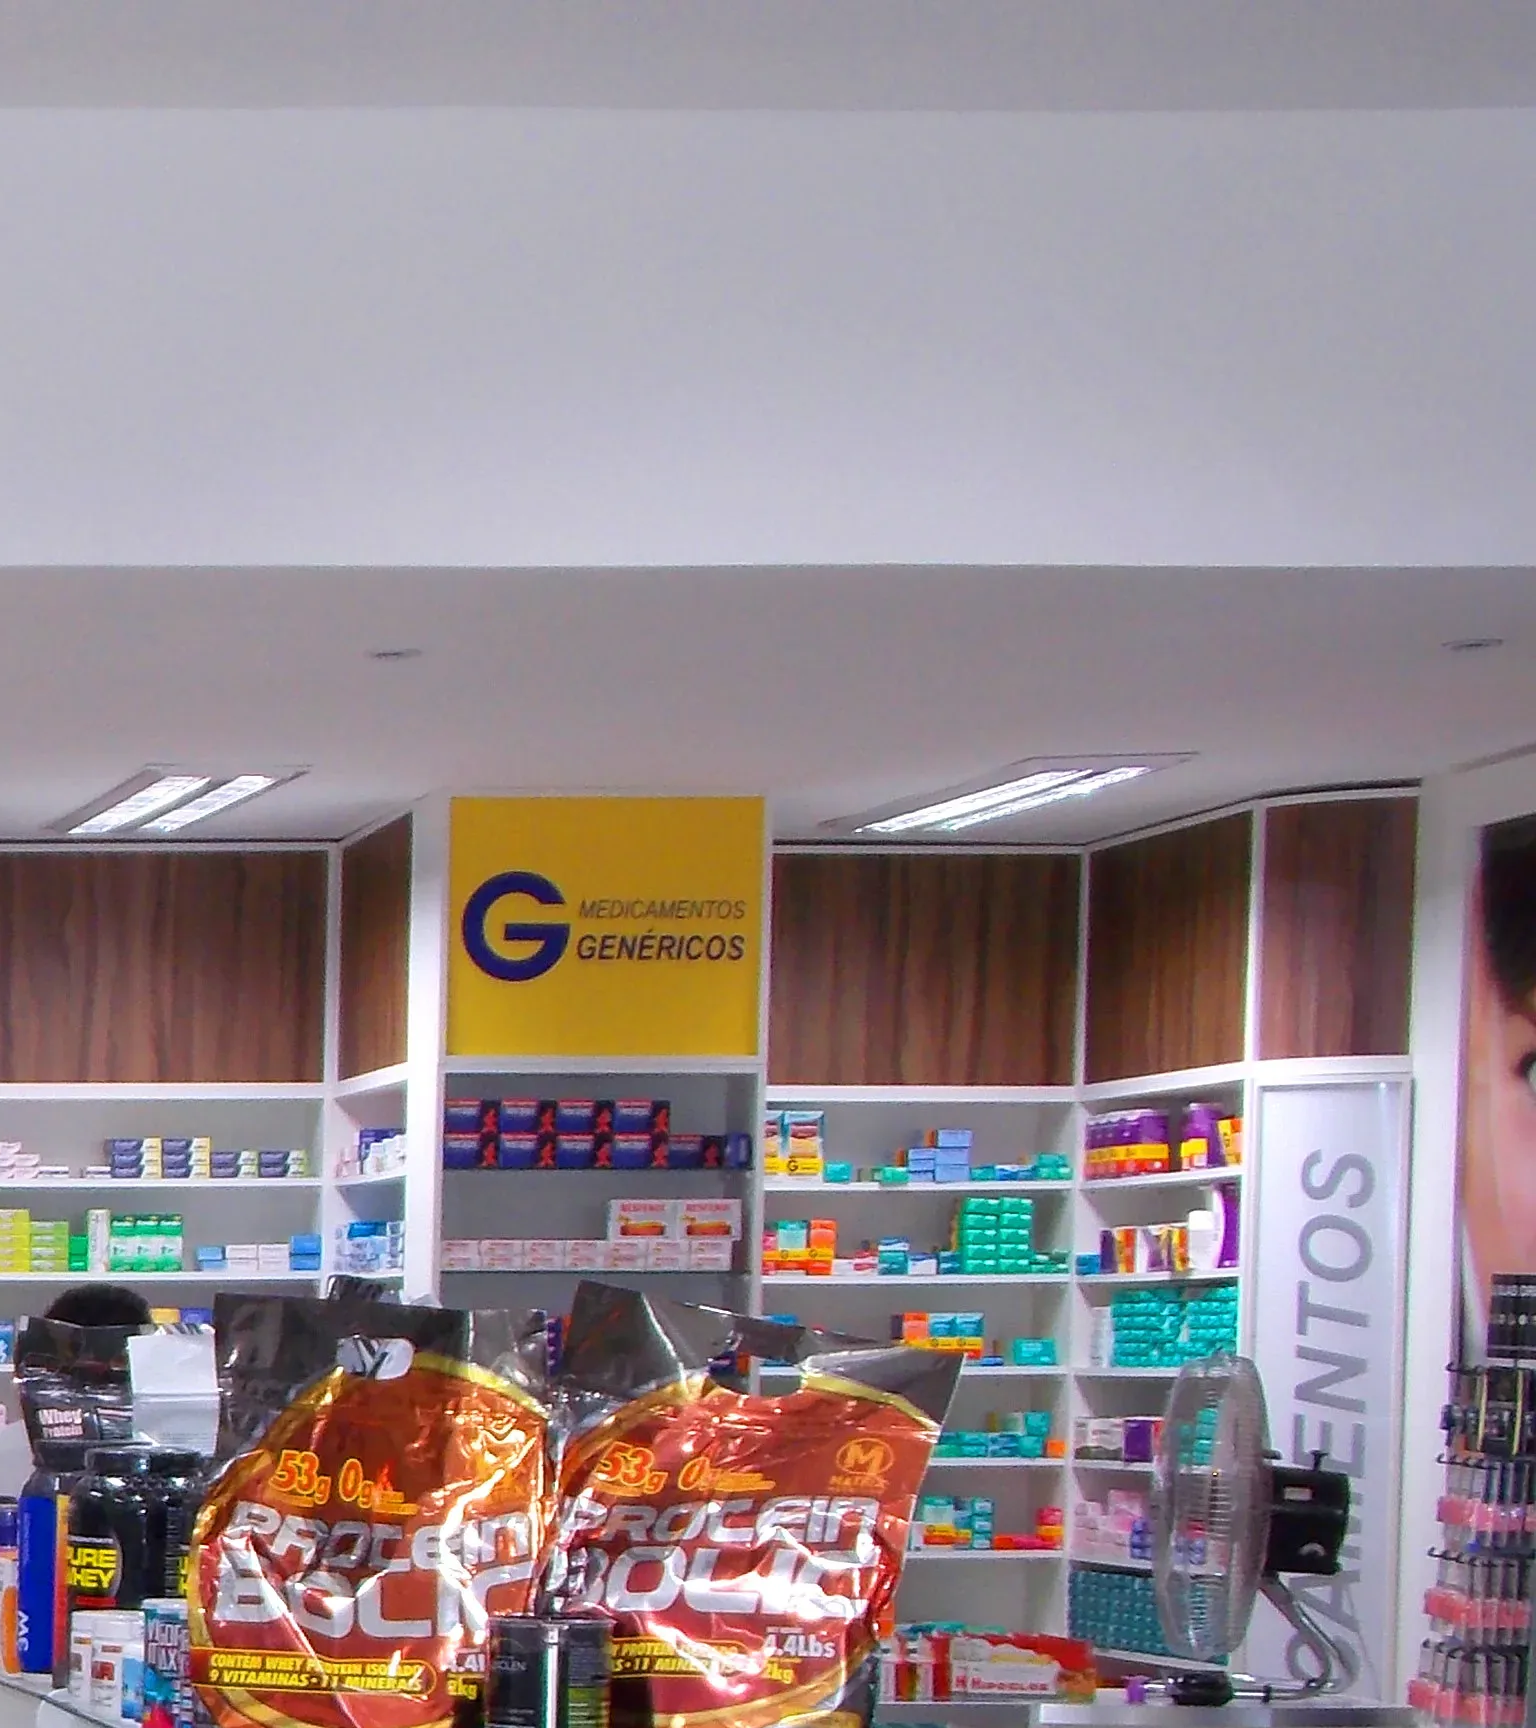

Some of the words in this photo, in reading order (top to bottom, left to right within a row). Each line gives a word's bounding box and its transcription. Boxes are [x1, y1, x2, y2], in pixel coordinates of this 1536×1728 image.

[578, 898, 747, 920] MEDICAMENTOS
[461, 870, 570, 982] G
[576, 928, 746, 961] GENÉRICOS
[269, 1450, 332, 1505] 53g
[594, 1441, 669, 1496] 53g
[209, 1669, 218, 1684] 9
[222, 1670, 310, 1688] VITAMINAS
[266, 1655, 303, 1672] WHEY
